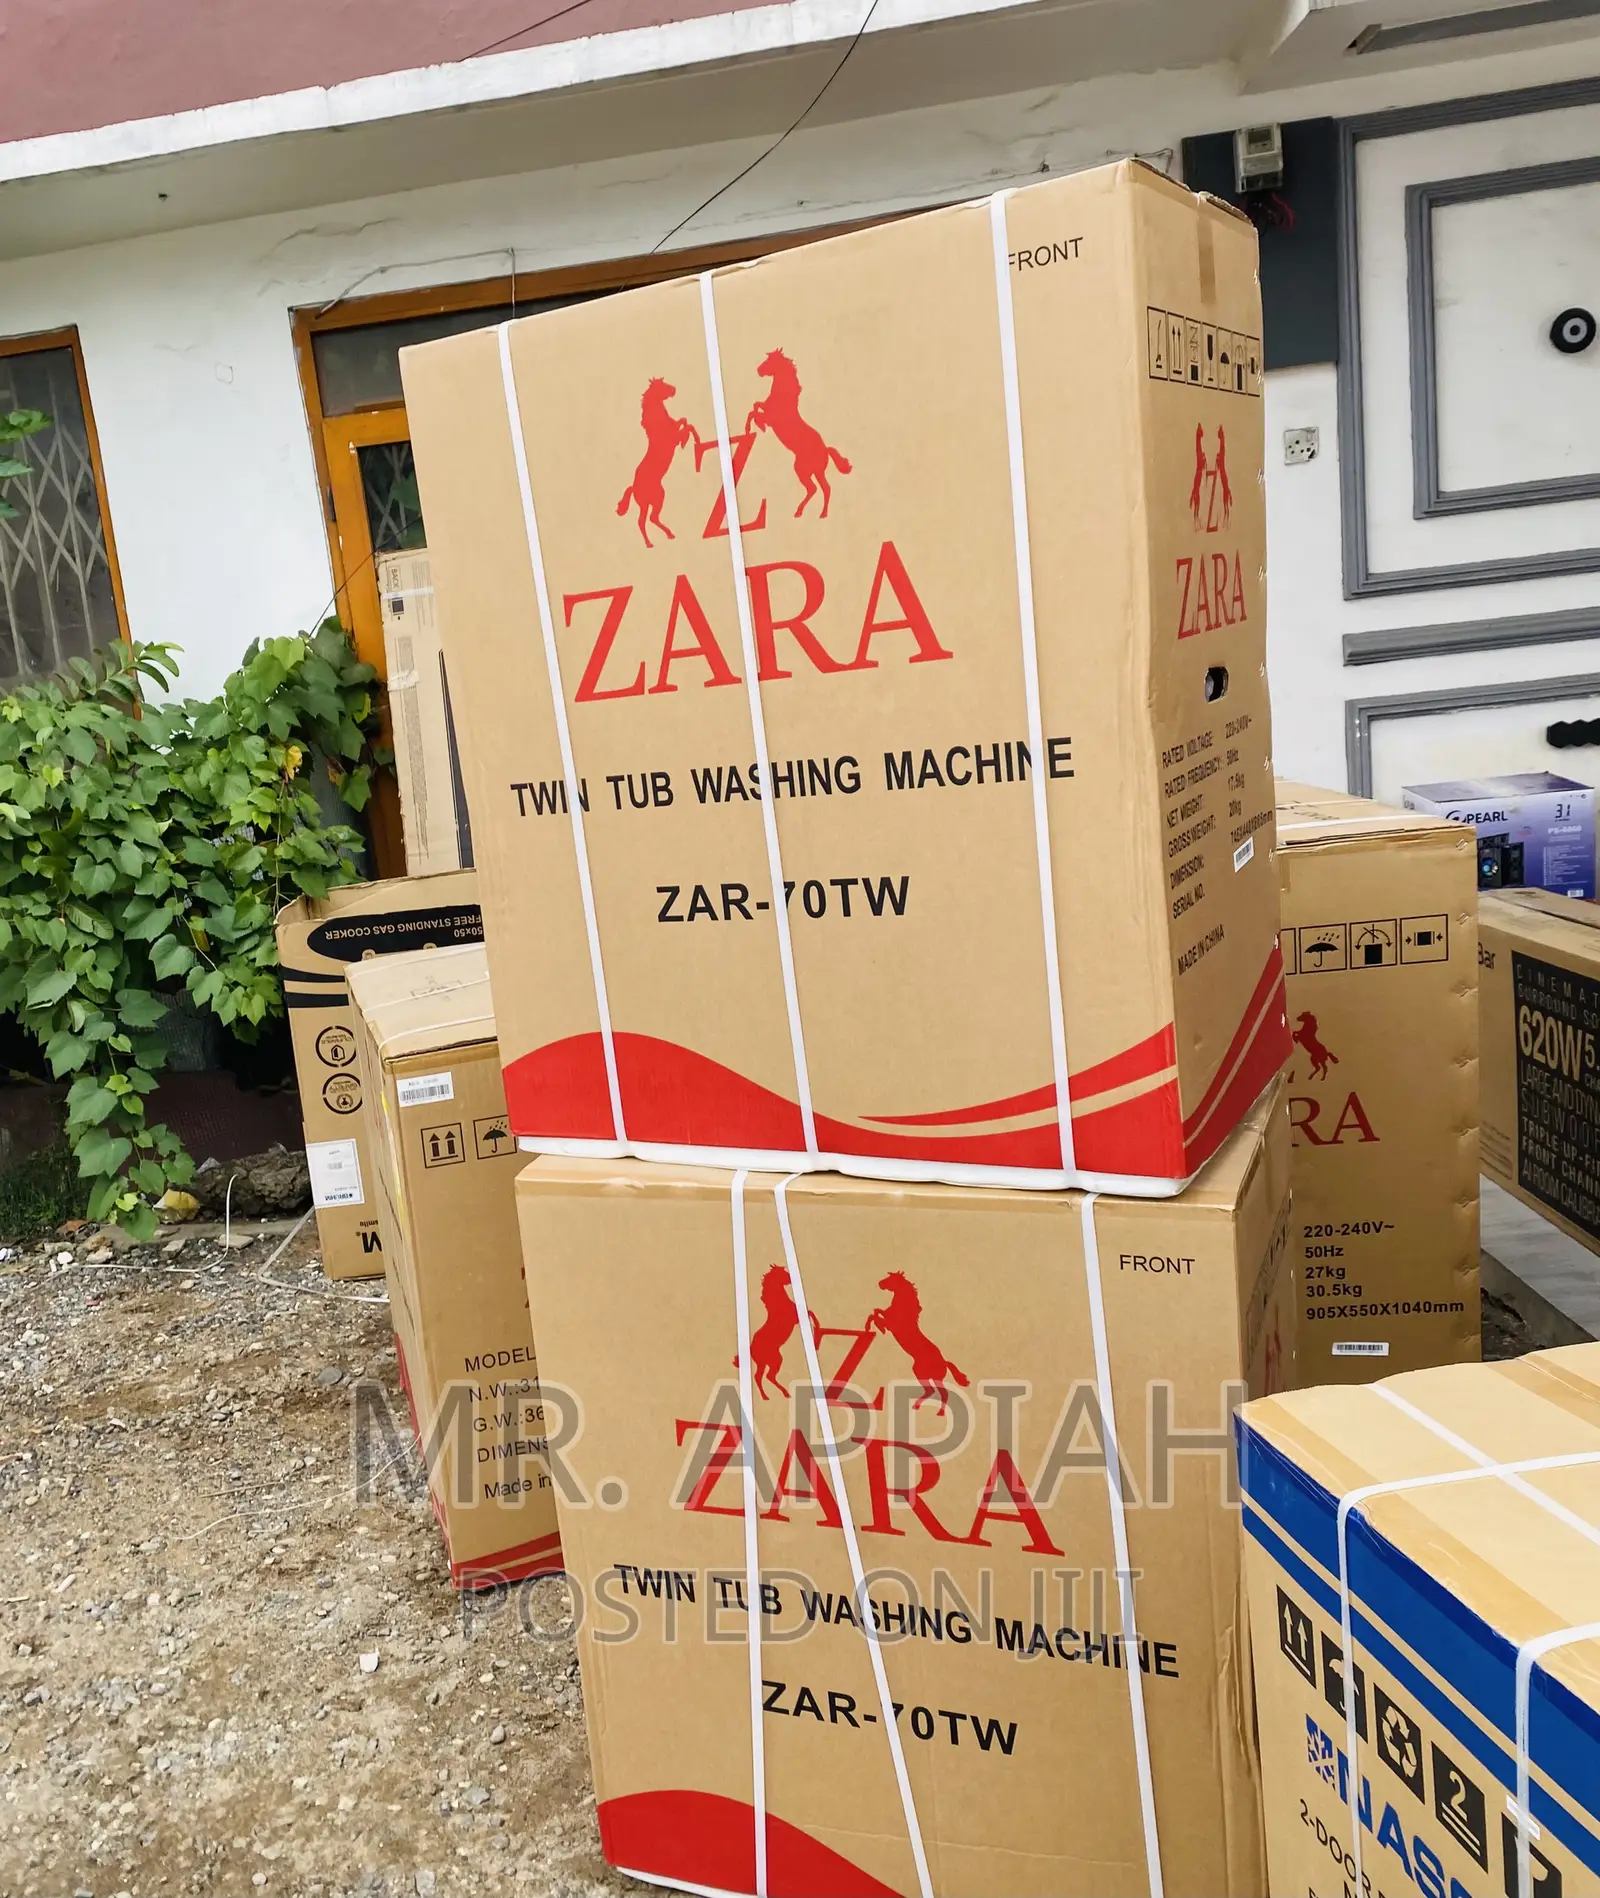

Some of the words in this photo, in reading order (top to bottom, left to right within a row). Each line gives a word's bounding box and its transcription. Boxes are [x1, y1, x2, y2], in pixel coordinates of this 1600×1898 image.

[1176, 550, 1246, 640] ZARA
[563, 541, 953, 703] ZARA
[1162, 745, 1184, 768] RATED
[510, 778, 590, 816] TWIN
[606, 772, 674, 810] TUB
[691, 755, 862, 804] WASHING
[884, 737, 1074, 791] MACHINE
[1165, 774, 1186, 798] RATED
[1167, 808, 1178, 828] NET
[1467, 811, 1508, 824] PEARL
[656, 875, 910, 922] ZAR-70TW
[1172, 890, 1195, 919] SERIAL
[325, 926, 370, 940] COOKER
[373, 924, 395, 935] GAS
[398, 917, 451, 932] STANDING
[453, 914, 482, 926] FREE
[453, 926, 483, 938] 50x50
[1178, 946, 1197, 976] MADE
[1197, 939, 1205, 960] IN
[1204, 923, 1225, 953] CHINA
[1517, 983, 1577, 1020] SURROUND
[1583, 1009, 1600, 1029] SO
[1519, 1005, 1583, 1081] 620W
[1521, 1060, 1552, 1099] LARGE
[1289, 1091, 1380, 1147] RA
[1522, 1116, 1559, 1152] TRIPLE
[1522, 1135, 1557, 1170] FRONT
[1304, 1221, 1395, 1238] 220-240V~
[1119, 1254, 1196, 1275] FRONT
[1305, 1245, 1344, 1258] 50Hz
[1305, 1266, 1346, 1280] 27kg
[1306, 1283, 1362, 1298] 30.5kg
[1307, 1301, 1465, 1320] 905X550X1040mm
[465, 1346, 537, 1373] MODEL
[484, 1478, 532, 1499] Made
[538, 1473, 552, 1488] in
[675, 1418, 1066, 1557] ZARA
[613, 1564, 696, 1603] TWIN
[712, 1577, 782, 1615] TUB
[800, 1589, 971, 1644] WASHING
[995, 1617, 1179, 1678] MACHINE
[1337, 1747, 1473, 1898] NAS
